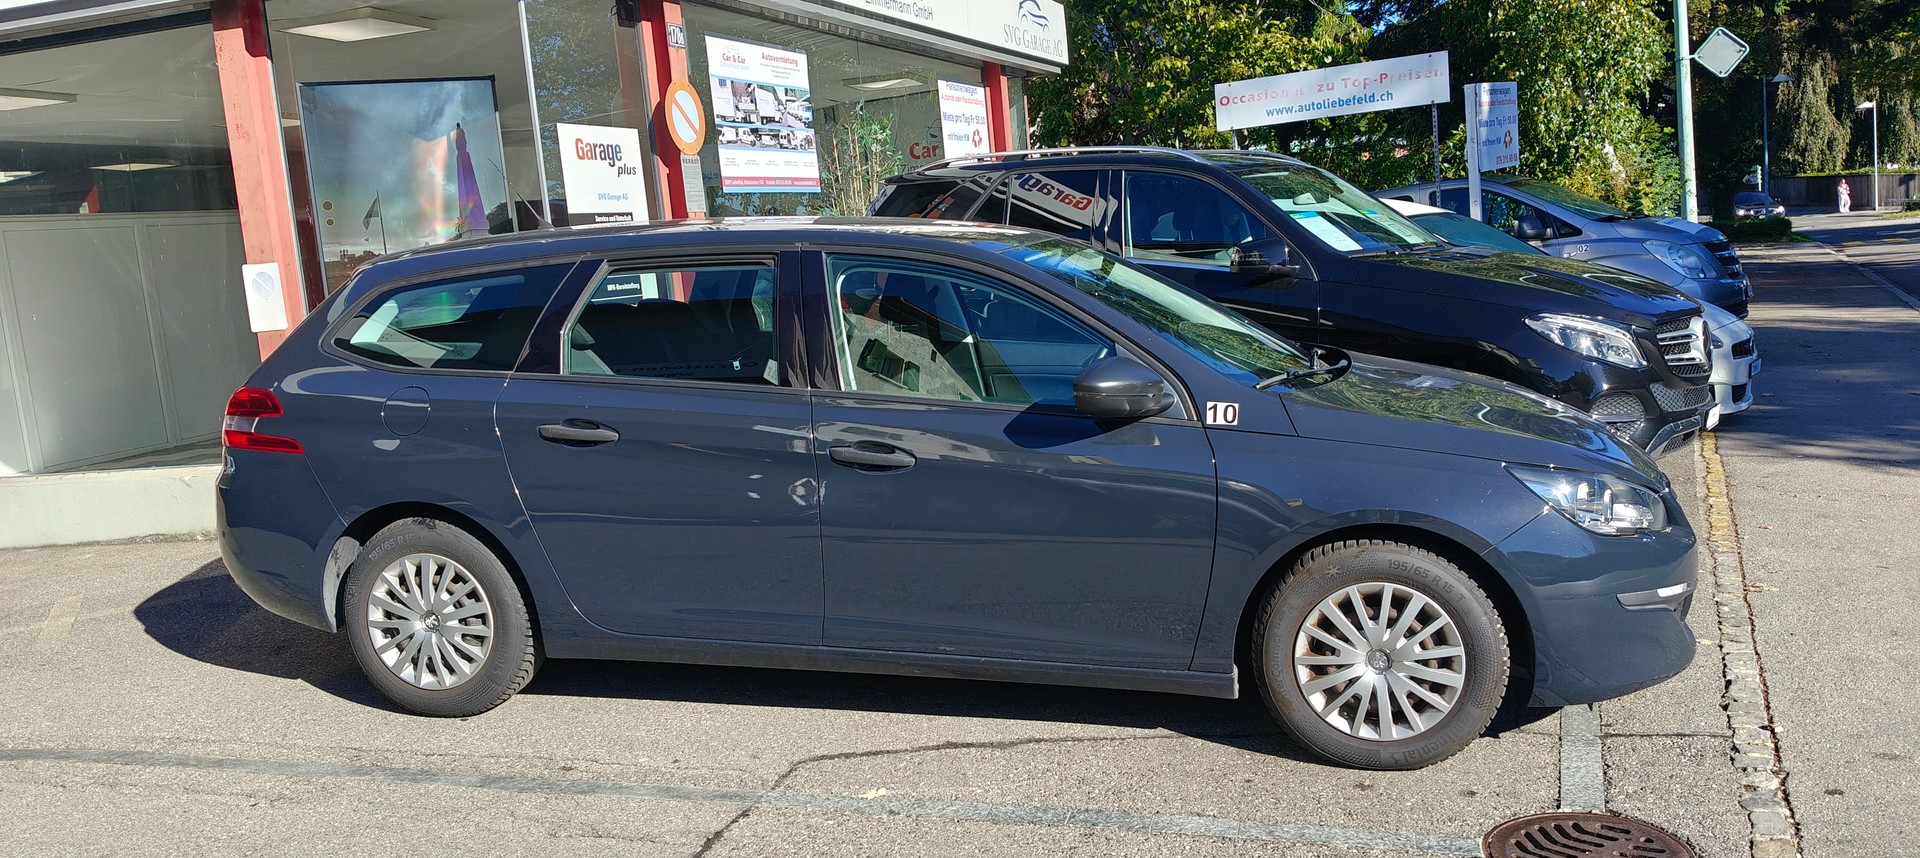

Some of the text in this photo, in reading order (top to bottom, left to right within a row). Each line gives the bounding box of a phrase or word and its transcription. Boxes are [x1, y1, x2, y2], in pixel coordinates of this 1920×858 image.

[913, 2, 933, 21] GmbH
[1003, 23, 1021, 46] SVG
[1053, 38, 1063, 57] AG
[722, 53, 731, 62] Car
[737, 55, 746, 64] Car
[1317, 81, 1335, 92] zu
[1341, 66, 1444, 91] Top-Preisen
[1265, 90, 1394, 118] www.autoliebefeld.ch
[962, 114, 970, 126] Tag
[575, 138, 622, 167] Garage
[909, 142, 940, 160] Car
[617, 163, 637, 177] plus
[607, 193, 622, 201] Garage
[1578, 244, 1589, 252] 02
[1208, 403, 1238, 424] 10
[368, 538, 395, 562] 195/65
[1387, 559, 1430, 579] 195/65
[1432, 574, 1442, 586] R
[1442, 581, 1456, 594] 15
